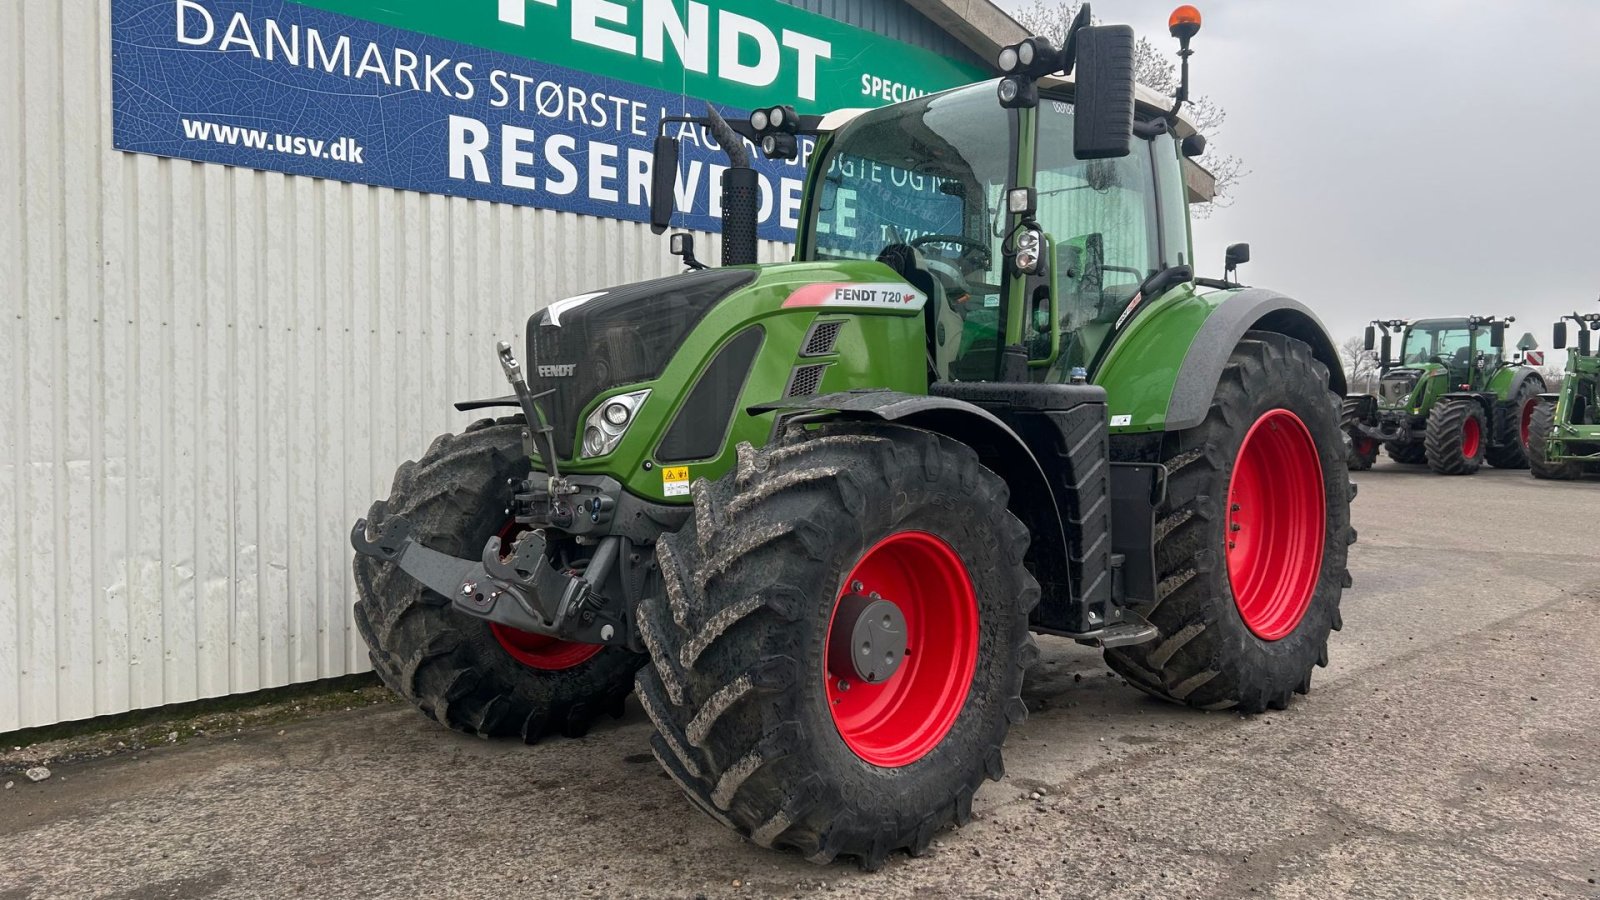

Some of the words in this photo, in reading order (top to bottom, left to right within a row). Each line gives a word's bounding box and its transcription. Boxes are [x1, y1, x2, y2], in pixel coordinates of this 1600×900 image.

[176, 0, 474, 100] DANMARKS
[490, 70, 648, 136] STØRSTE
[861, 73, 931, 103] SPECIA
[182, 119, 364, 164] www.usv.dk
[835, 288, 877, 302] FENDT
[881, 291, 901, 303] 720
[538, 364, 577, 377] FENDT
